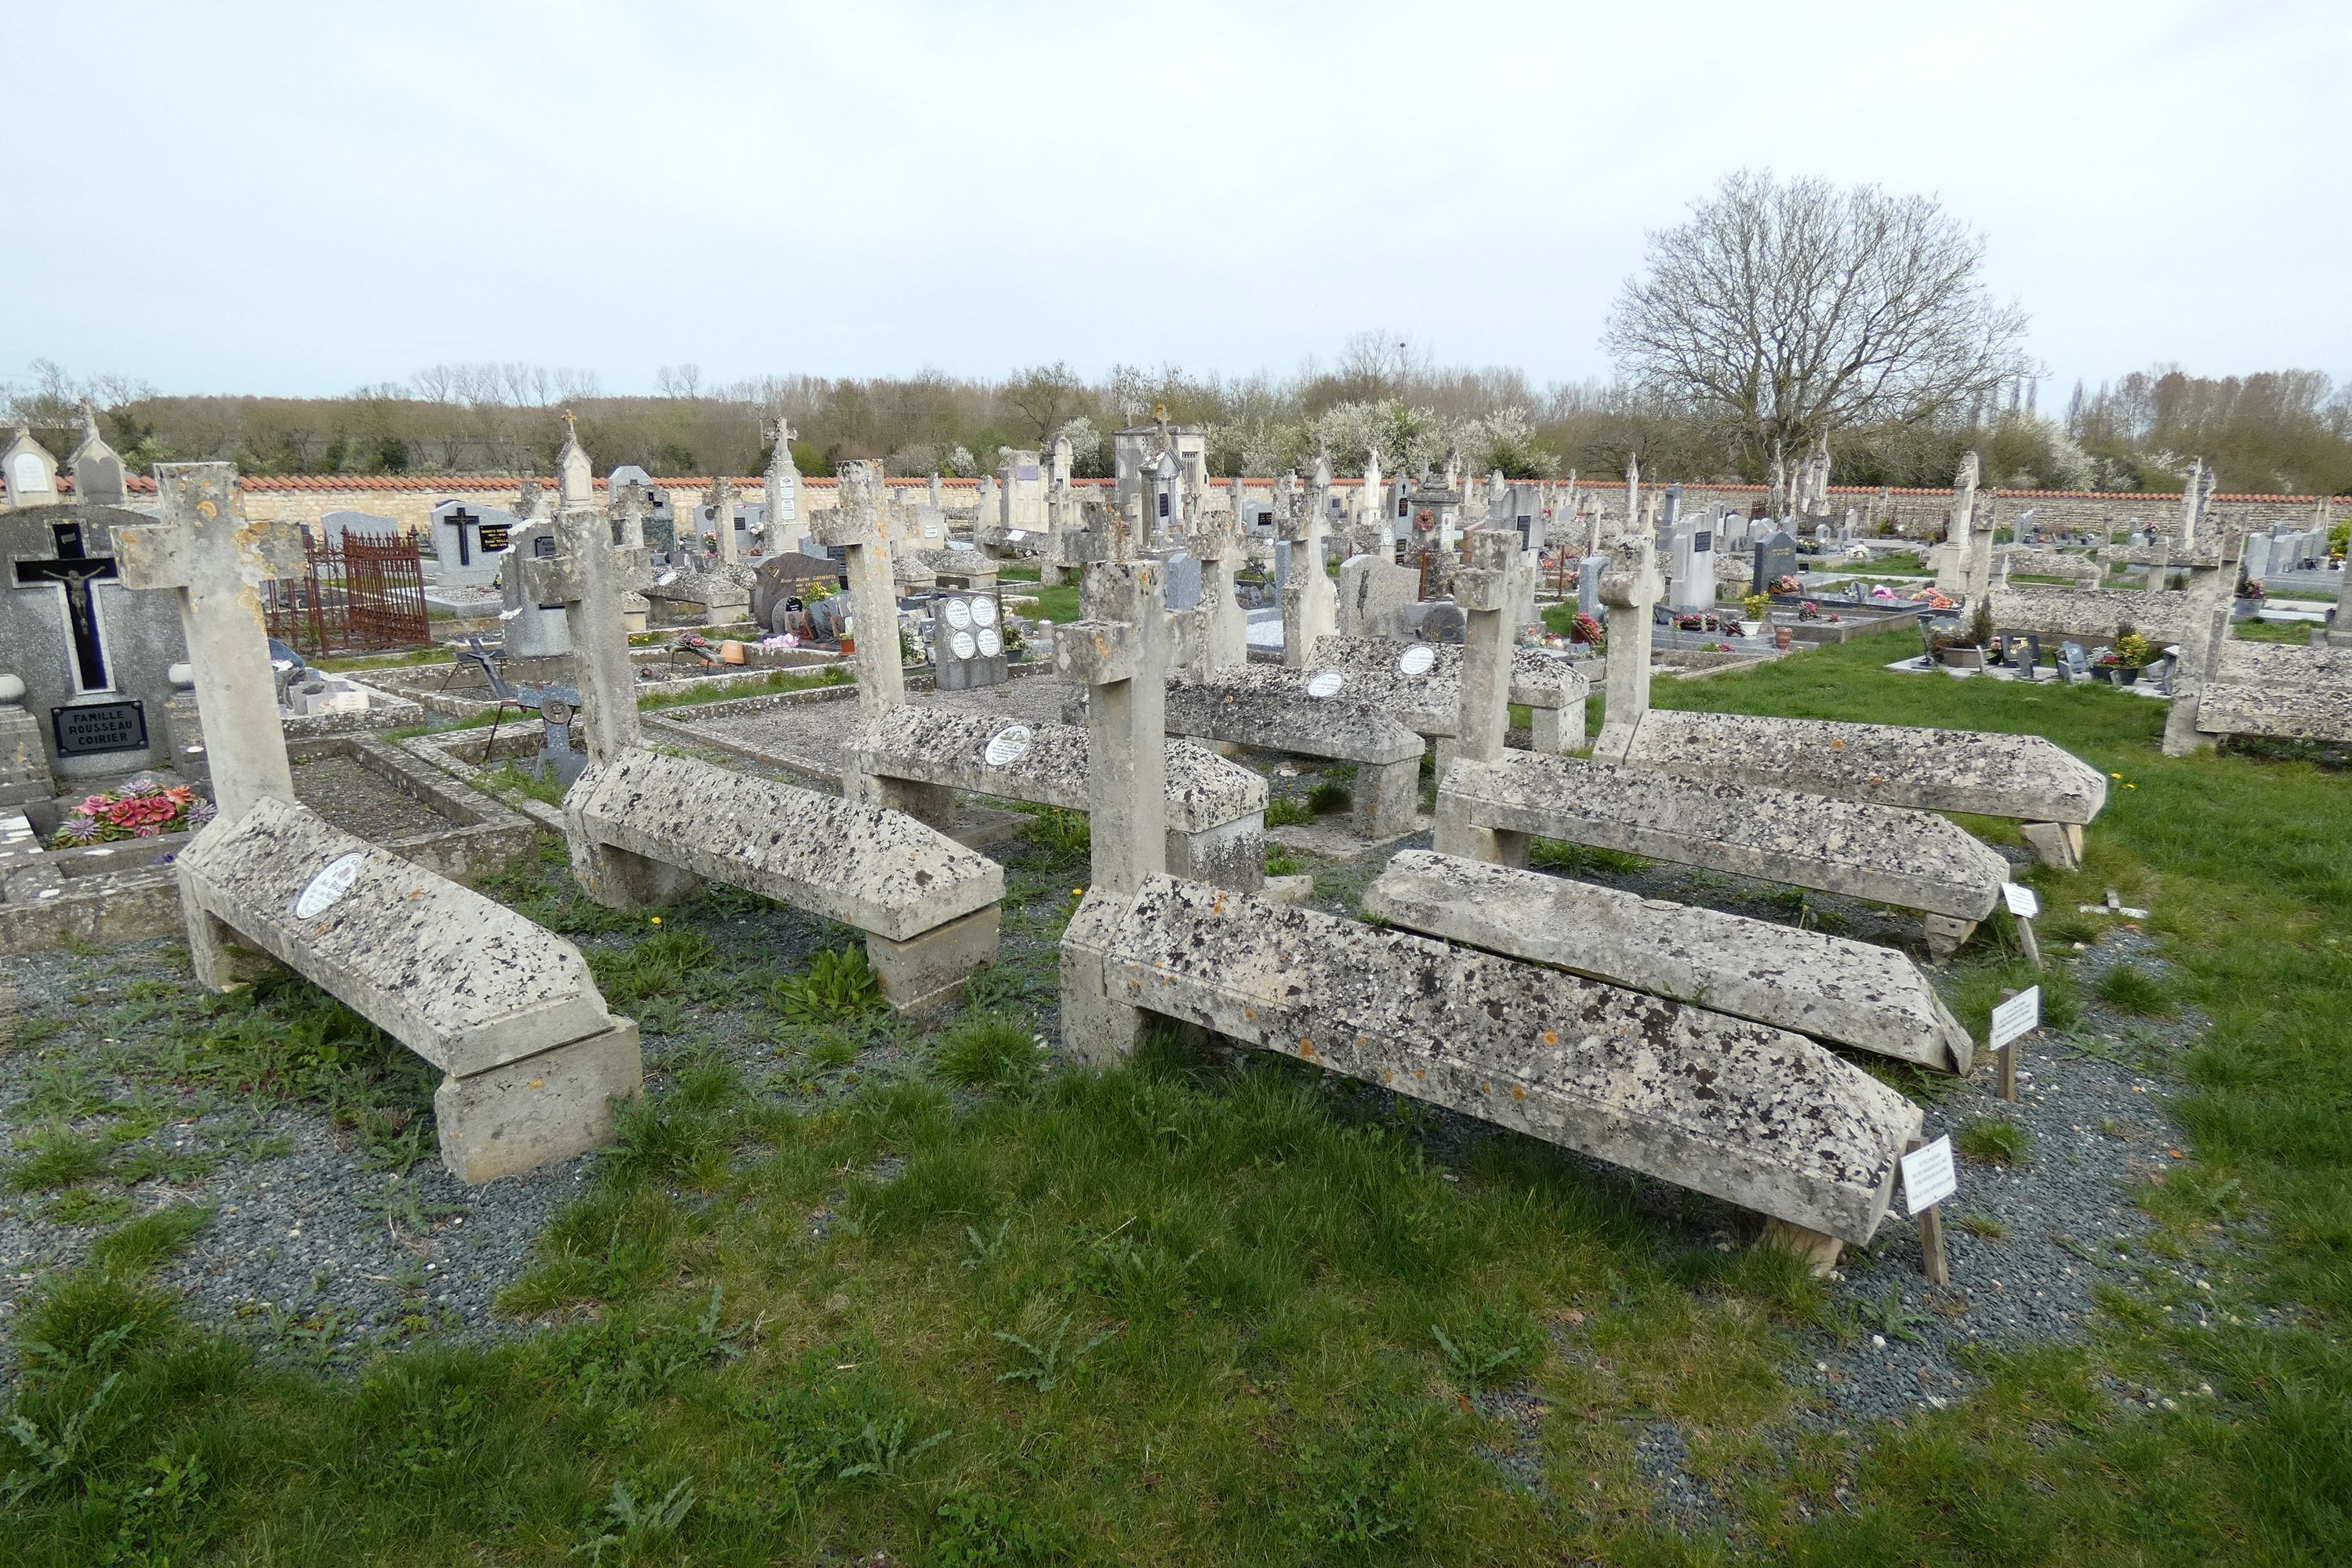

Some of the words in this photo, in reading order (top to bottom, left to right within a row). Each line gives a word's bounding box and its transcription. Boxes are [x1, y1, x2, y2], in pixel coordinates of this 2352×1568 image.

[74, 710, 124, 723] FAMILLE
[69, 720, 132, 735] ROUSSEAU
[78, 732, 129, 746] COIRIER
